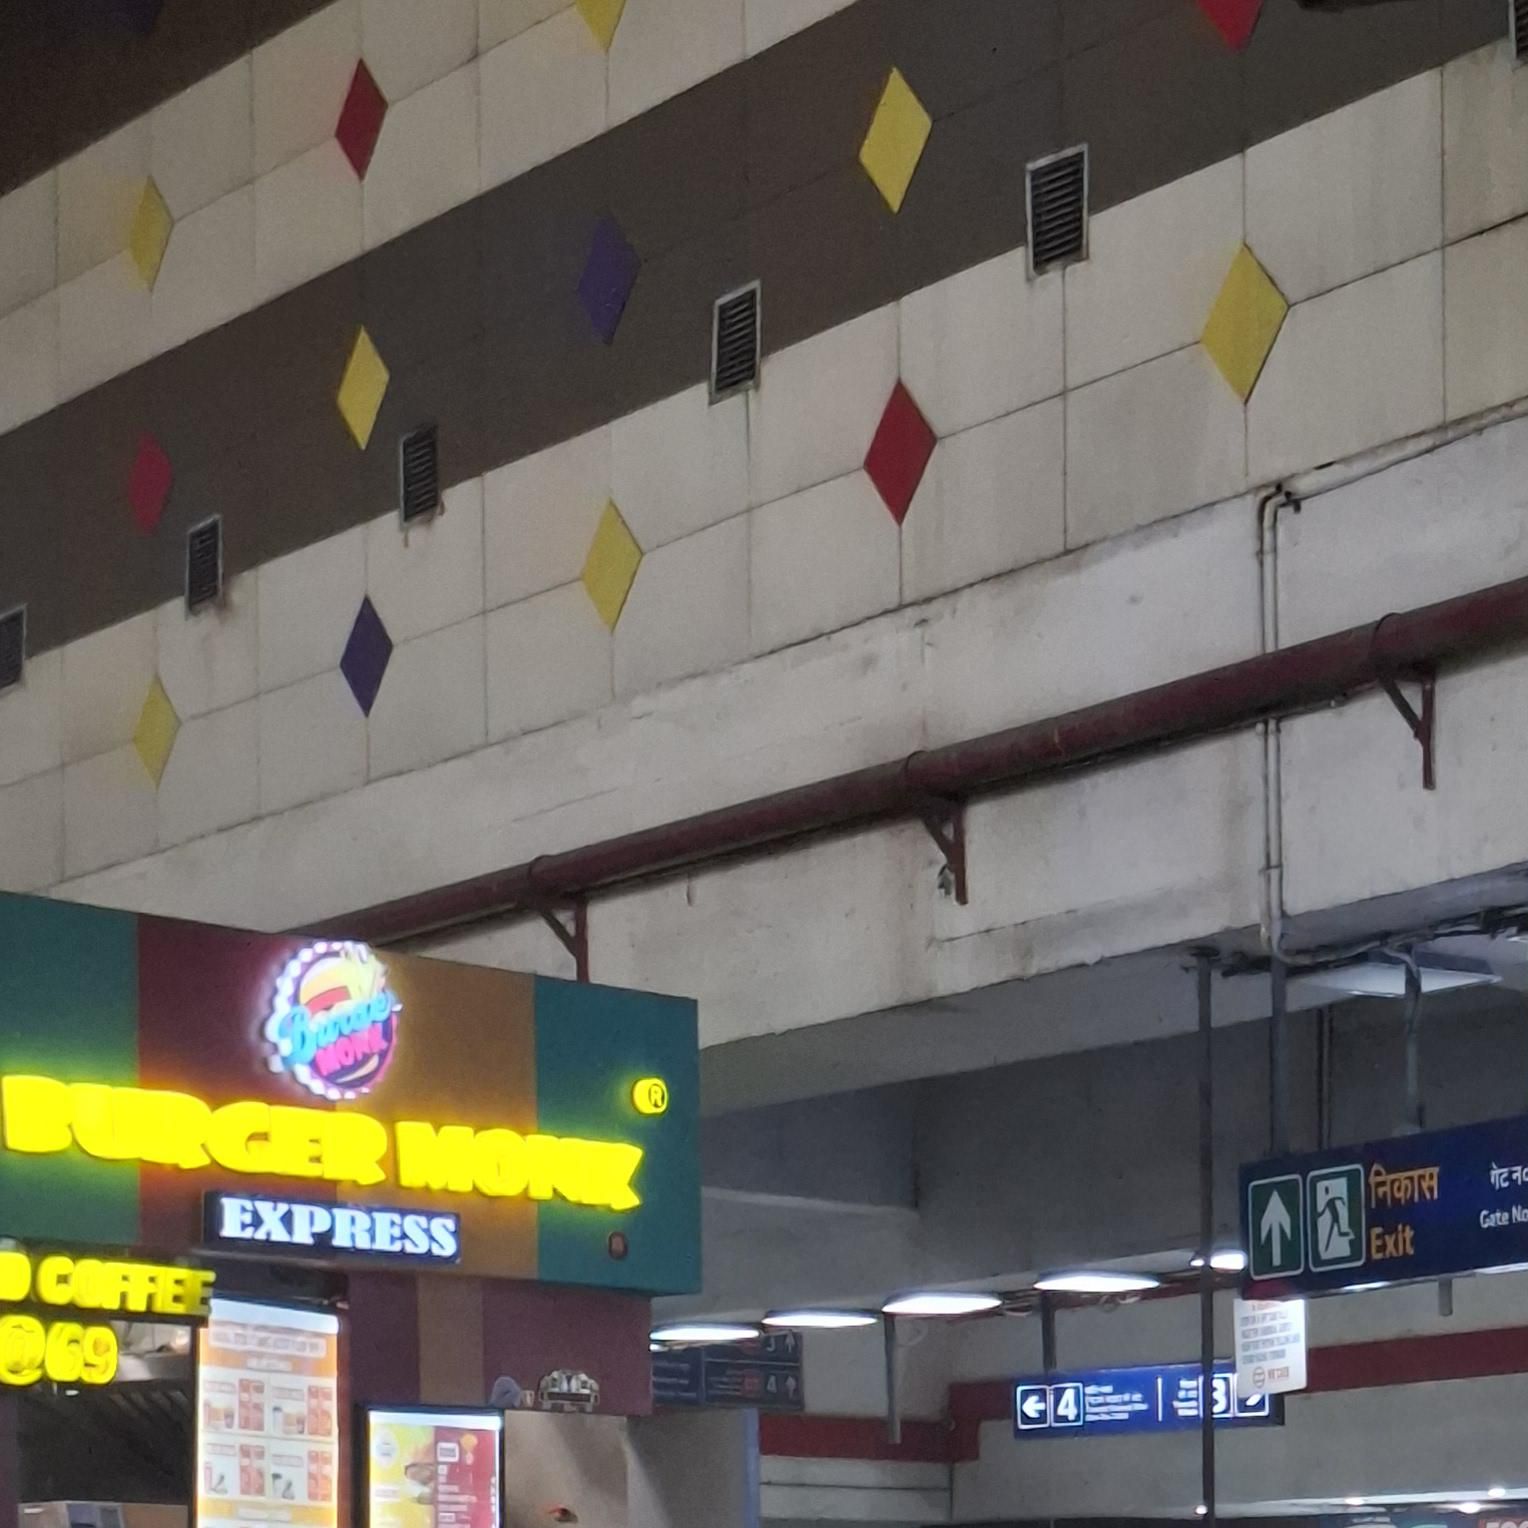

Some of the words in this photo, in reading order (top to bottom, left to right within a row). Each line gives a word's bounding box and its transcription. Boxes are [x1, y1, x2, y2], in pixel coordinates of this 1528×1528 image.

[2, 1074, 387, 1185] BURGER
[397, 1121, 644, 1211] MONK
[1369, 1162, 1440, 1209] निकास
[1489, 1161, 1510, 1190] गेट
[219, 1196, 457, 1260] EXPRESS
[1479, 1209, 1509, 1229] Gate
[1370, 1222, 1415, 1260] Exit
[37, 1255, 216, 1316] COFFEE
[1057, 1388, 1077, 1421] 4
